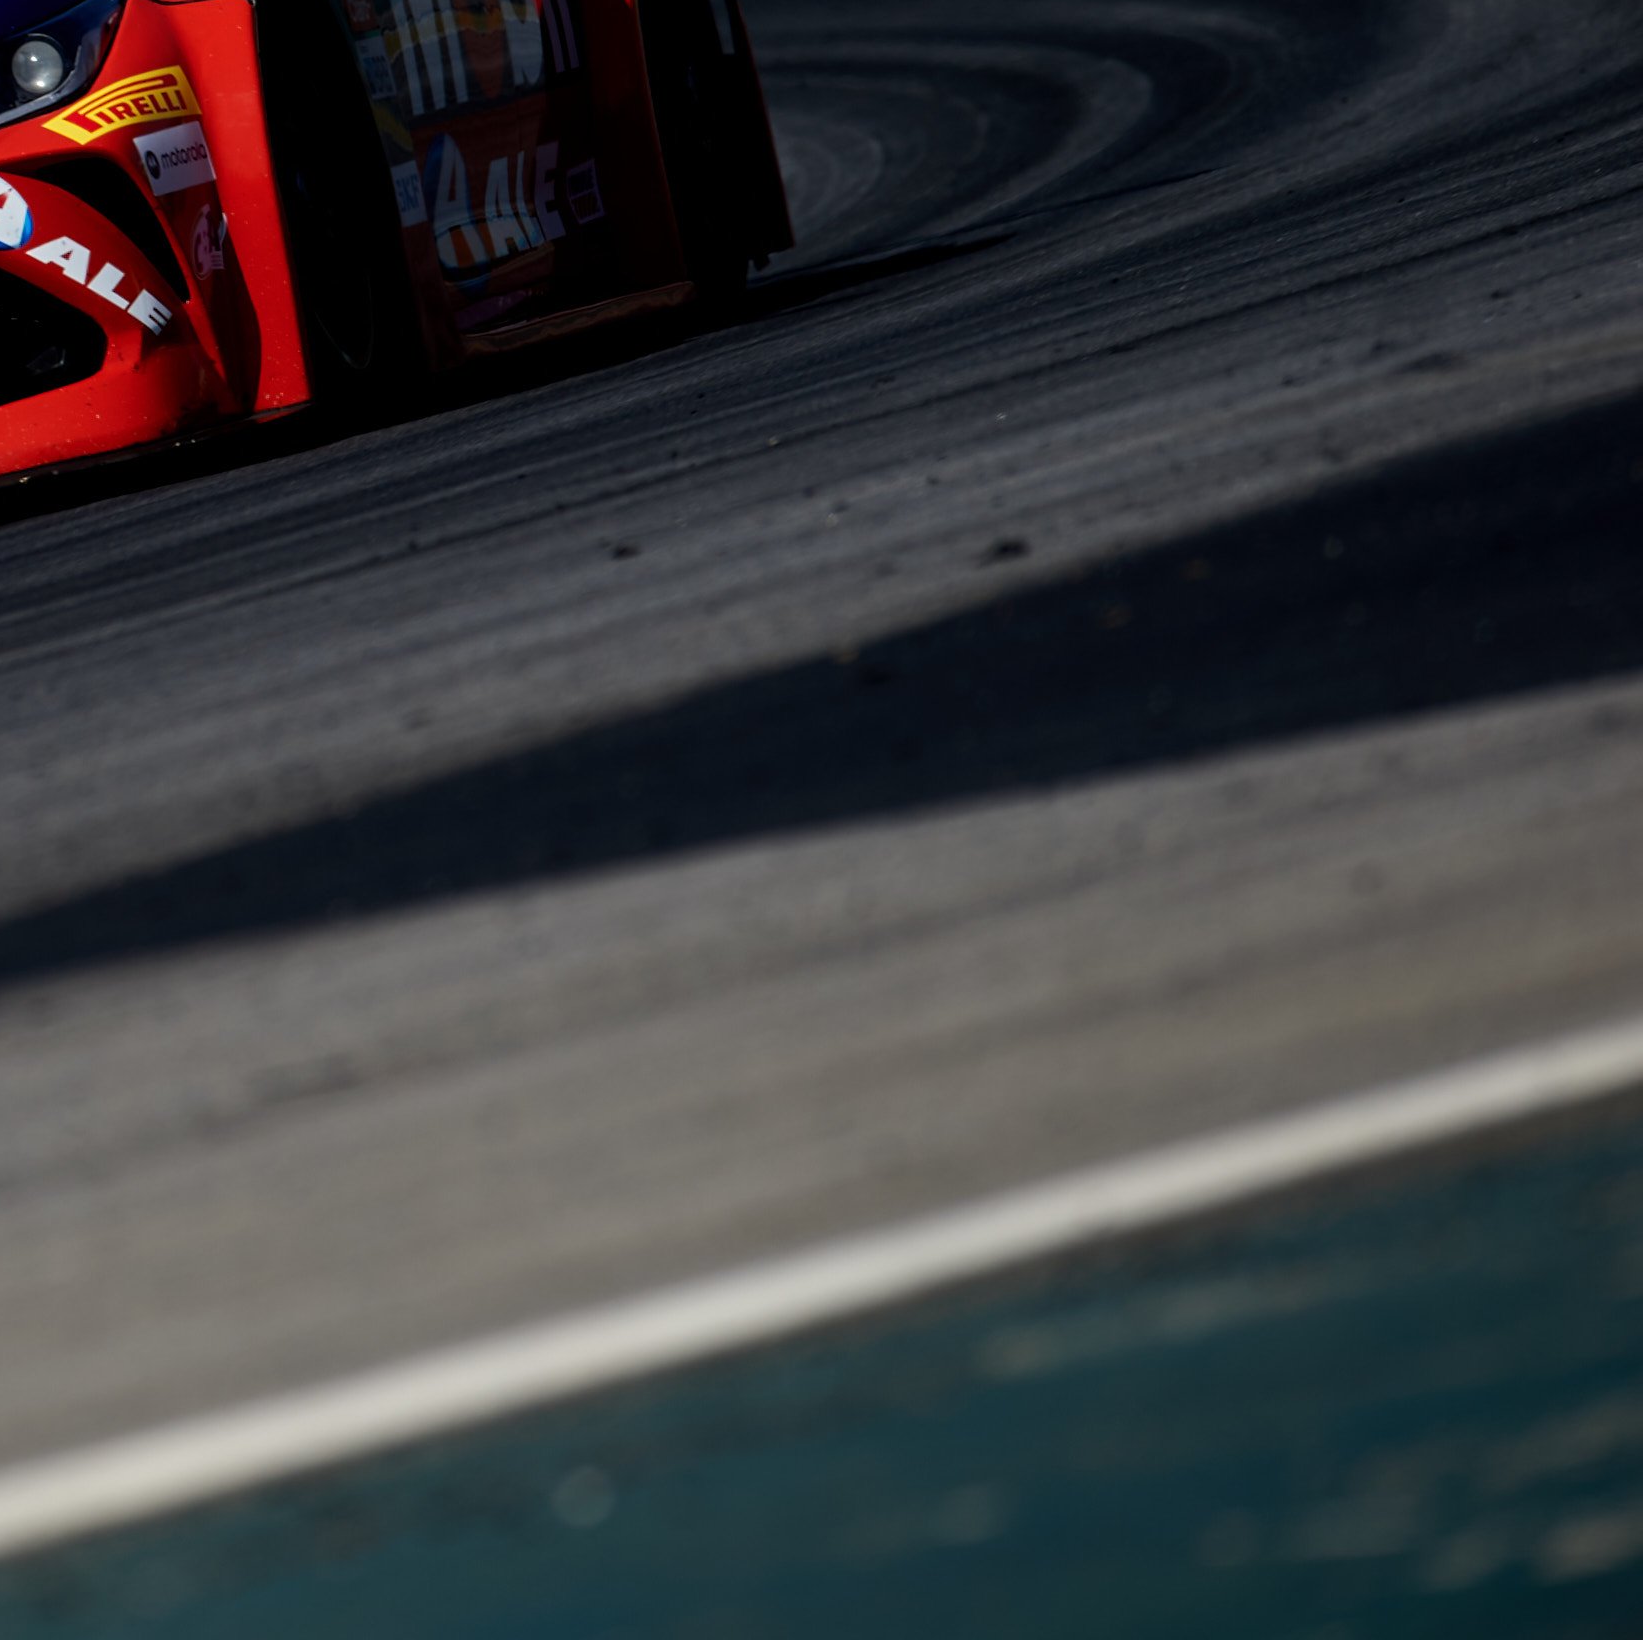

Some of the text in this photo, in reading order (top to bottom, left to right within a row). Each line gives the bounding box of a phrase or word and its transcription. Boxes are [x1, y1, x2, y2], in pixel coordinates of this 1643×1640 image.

[62, 73, 188, 134] PIRELLI
[160, 142, 208, 169] motorola
[482, 141, 567, 258] ALE
[25, 236, 174, 336] ALE
